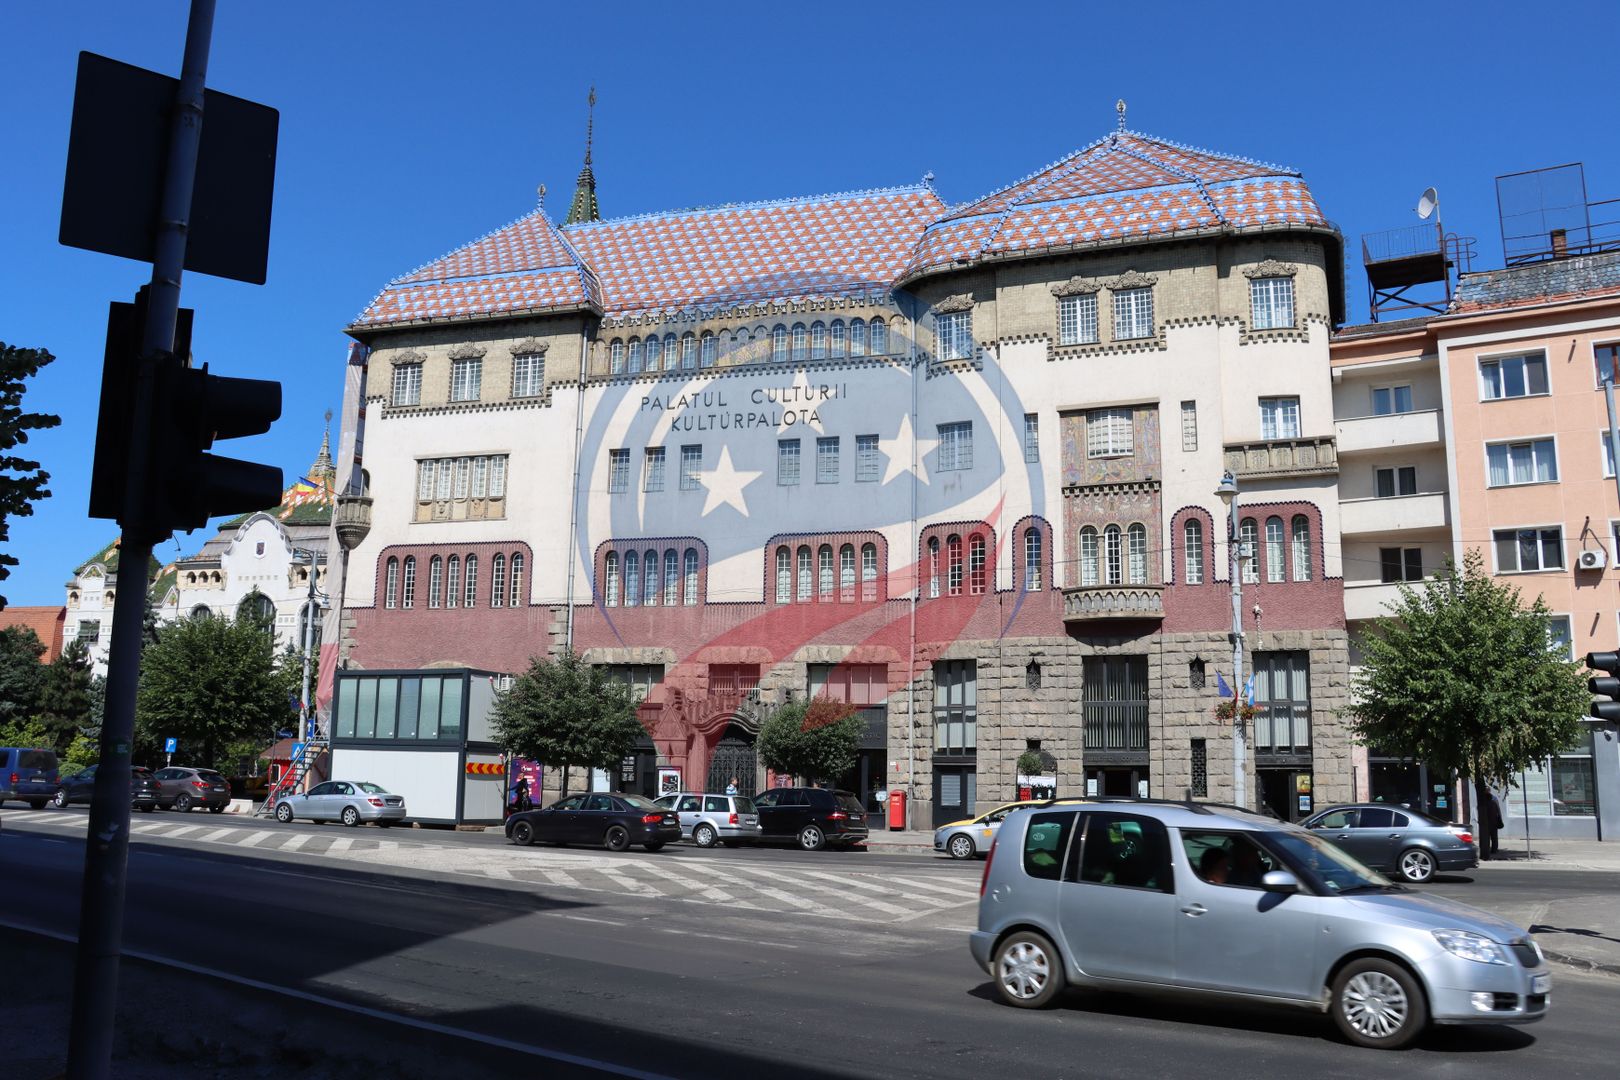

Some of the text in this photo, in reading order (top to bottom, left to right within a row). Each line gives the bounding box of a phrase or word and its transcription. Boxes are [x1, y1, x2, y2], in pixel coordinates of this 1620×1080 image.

[641, 383, 847, 412] PALATUL CULTURII
[671, 409, 821, 432] KULTÚRPALOTA
